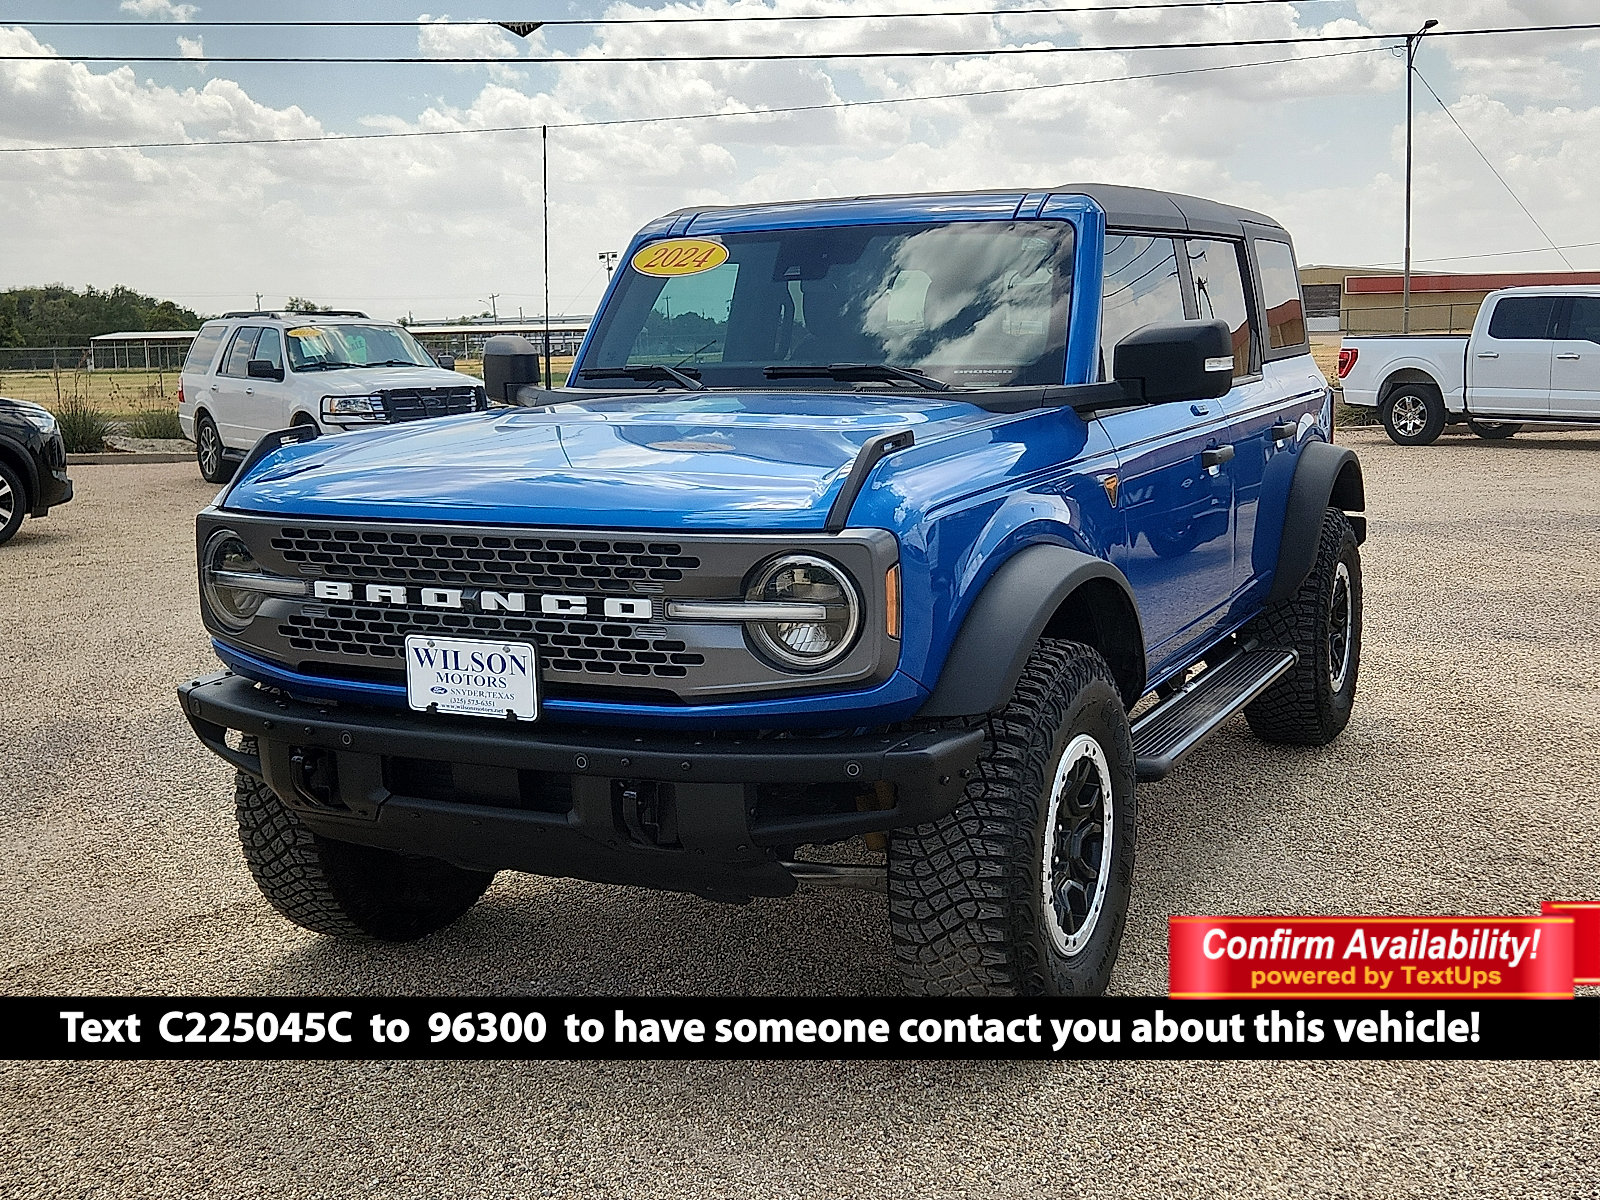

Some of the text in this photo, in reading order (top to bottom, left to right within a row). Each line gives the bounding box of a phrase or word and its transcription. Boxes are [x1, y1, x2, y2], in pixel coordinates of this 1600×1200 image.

[643, 246, 717, 269] 2024
[313, 580, 653, 619] BRONCO
[412, 647, 527, 676] WILSON
[436, 672, 507, 688] MOTORS
[441, 703, 504, 713] www.wilsonmotors.net
[449, 697, 495, 707] (325) 573-6351
